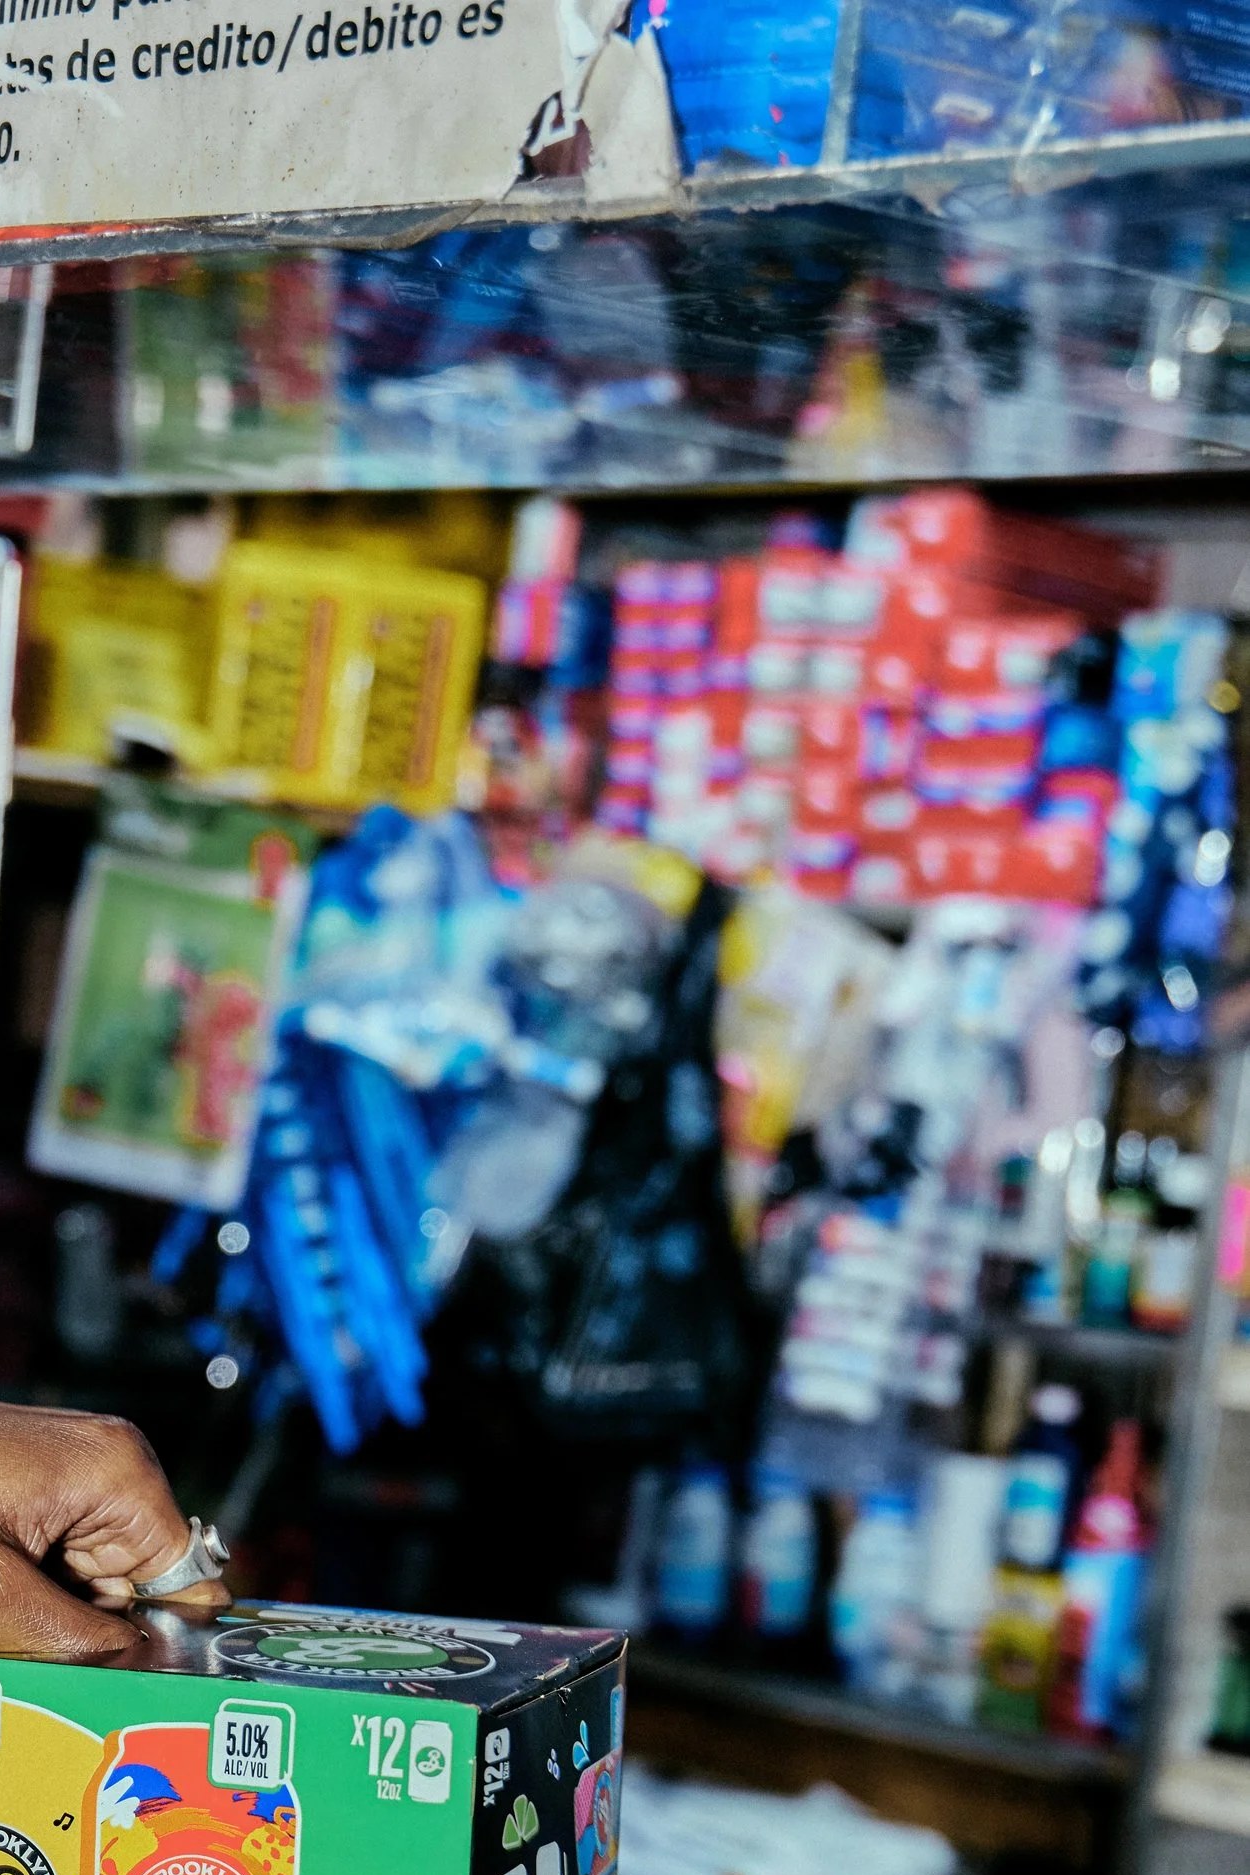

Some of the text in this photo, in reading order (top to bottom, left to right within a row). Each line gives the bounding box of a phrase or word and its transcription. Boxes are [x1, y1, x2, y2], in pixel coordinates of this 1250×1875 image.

[66, 38, 116, 83] de
[131, 2, 443, 80] credito/debito
[455, 0, 505, 39] es
[234, 1652, 456, 1677] BROOKLYN
[225, 1721, 269, 1761] 5.0%
[224, 1758, 269, 1780] ALC/VOL
